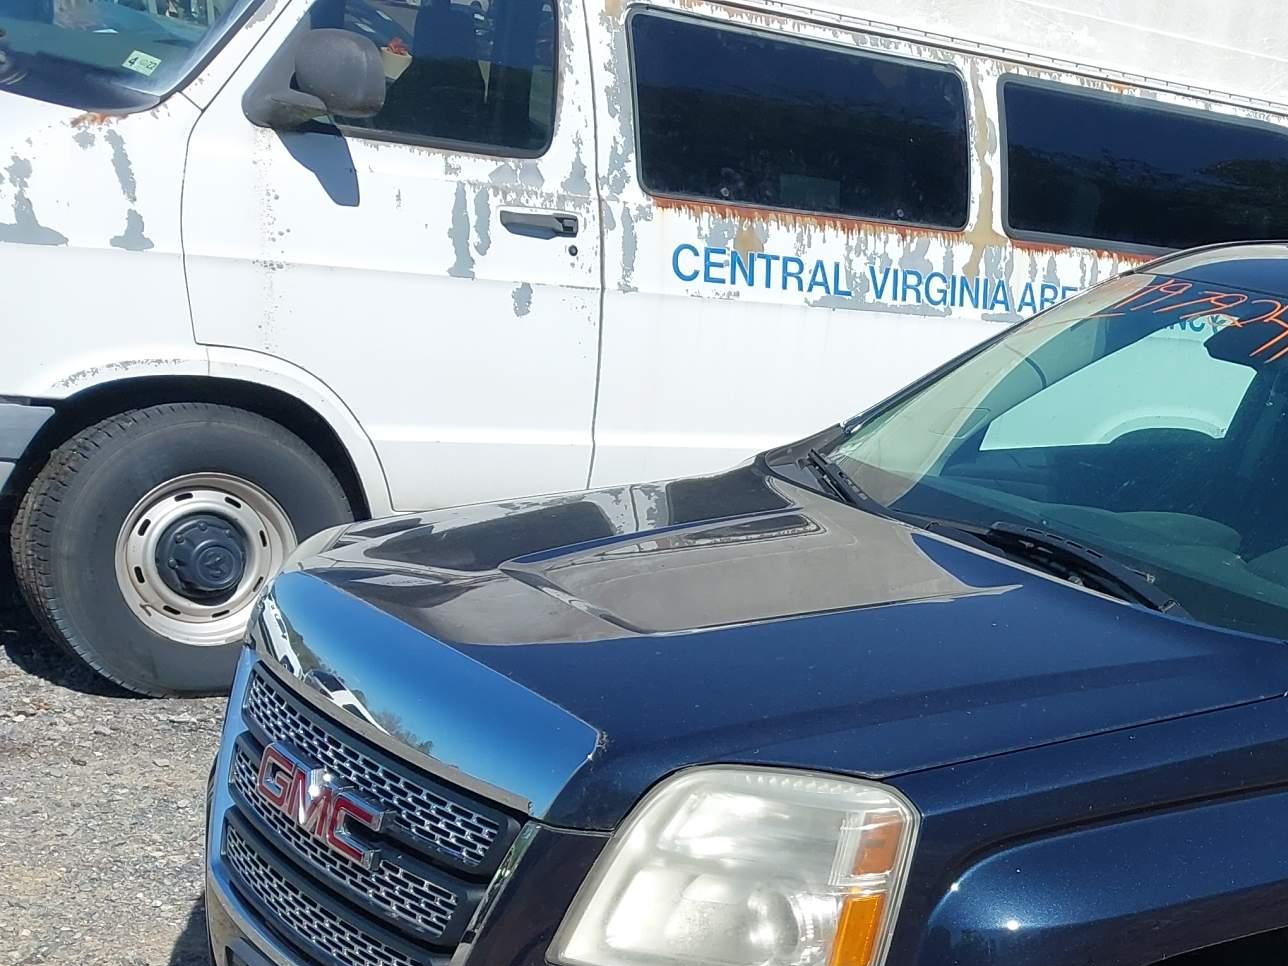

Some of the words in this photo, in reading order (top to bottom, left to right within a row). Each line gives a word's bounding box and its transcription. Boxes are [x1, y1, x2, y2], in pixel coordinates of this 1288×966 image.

[672, 243, 852, 297] CENTRAL
[868, 265, 1010, 312] VIRGINIA
[257, 741, 386, 872] GMC
